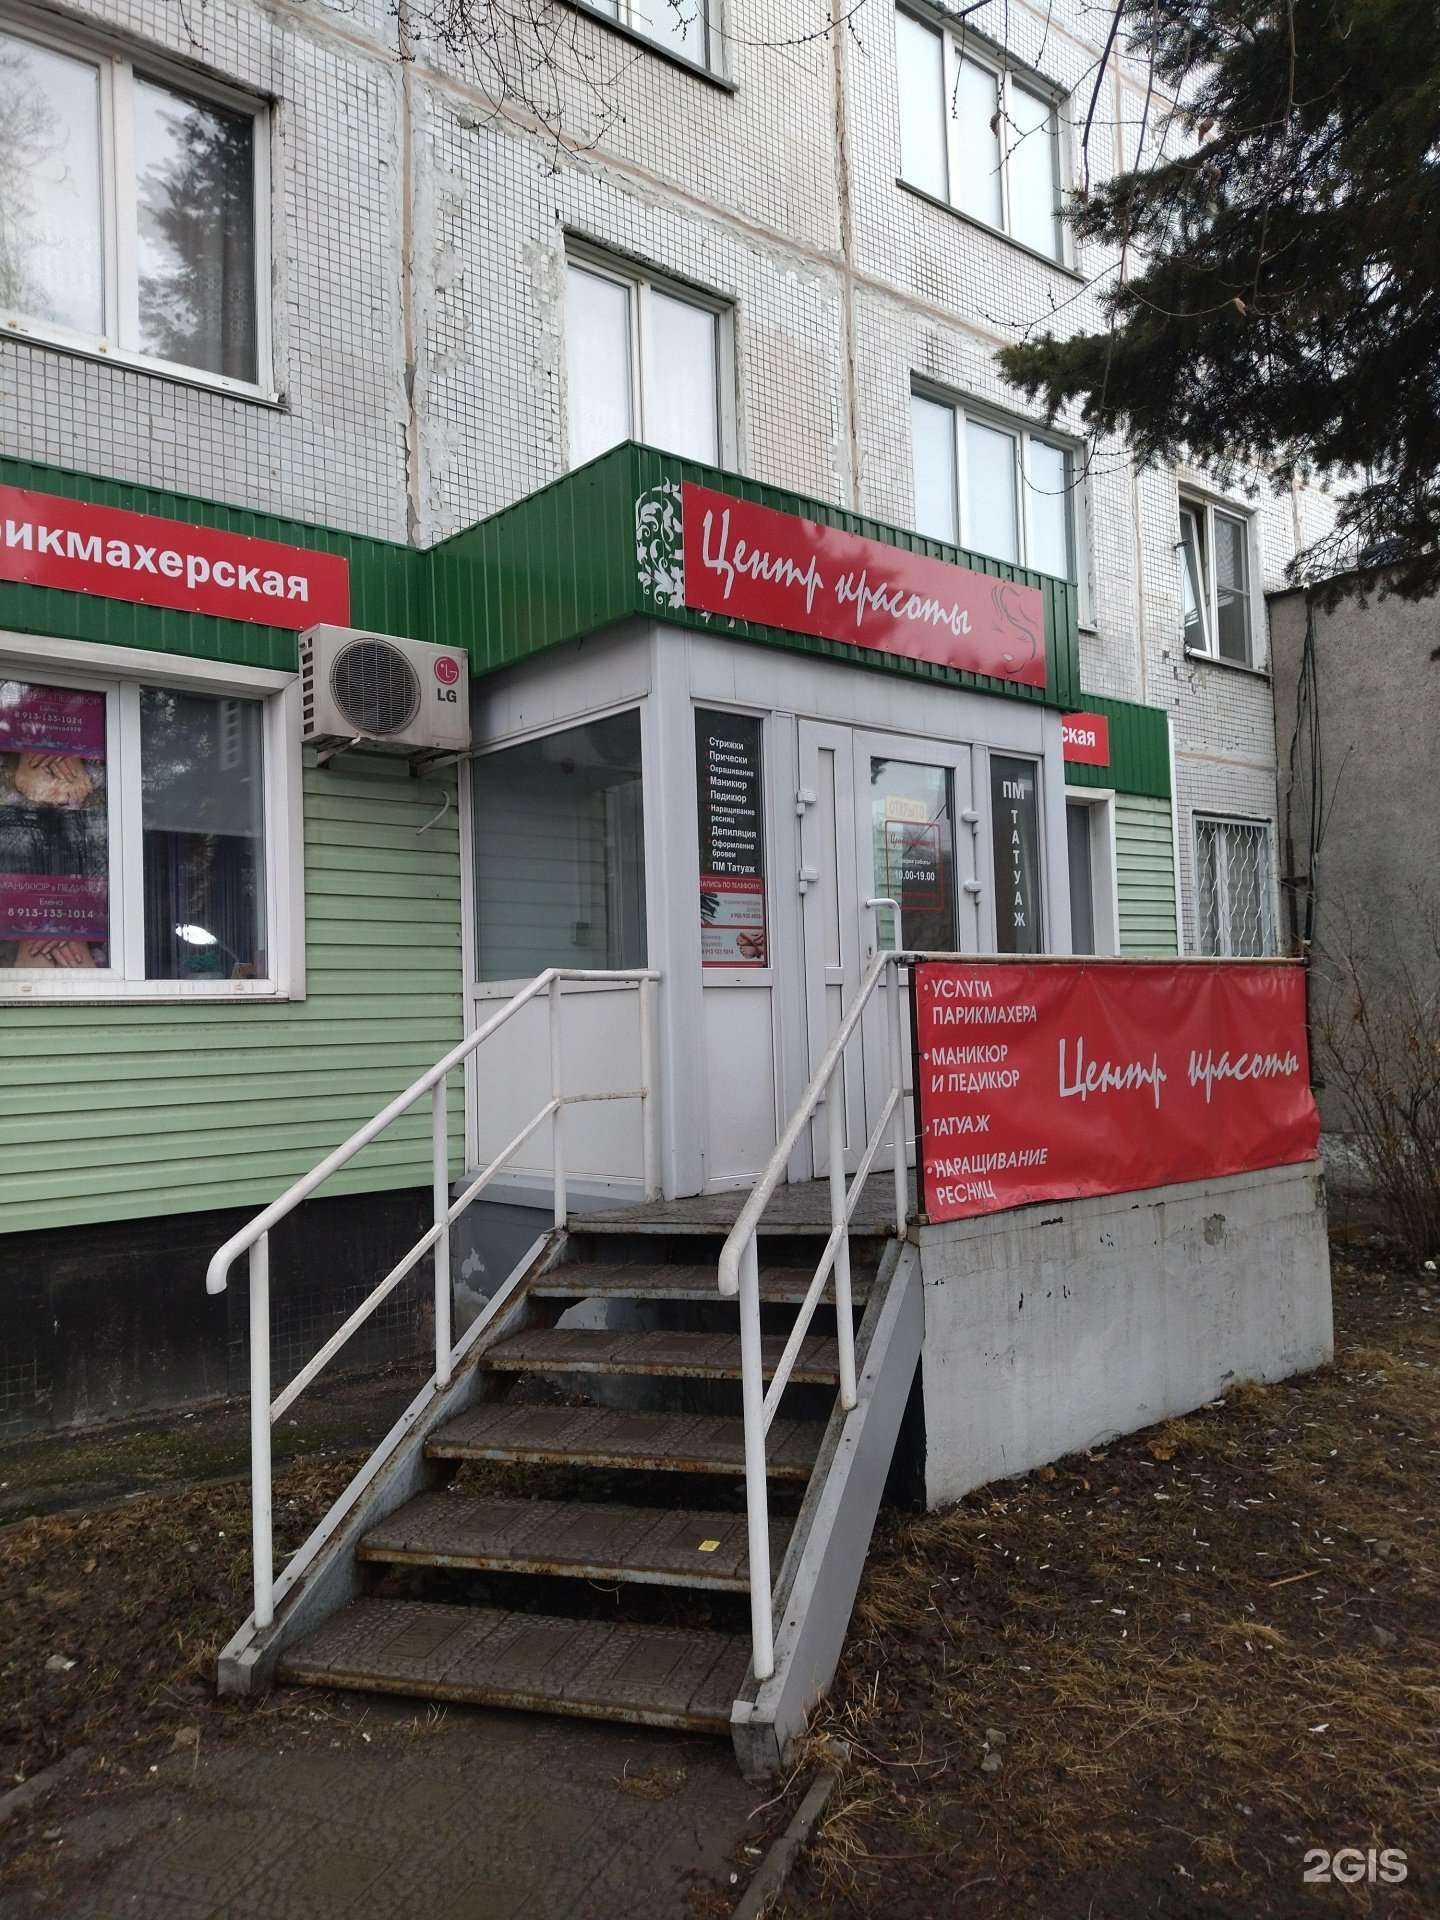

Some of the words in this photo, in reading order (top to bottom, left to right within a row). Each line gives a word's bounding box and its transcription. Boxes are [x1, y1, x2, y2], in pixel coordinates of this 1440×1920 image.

[0, 518, 309, 602] икмахерская
[702, 508, 824, 614] Центр
[834, 568, 972, 636] красоты
[437, 687, 457, 703] LG
[709, 736, 744, 750] Стрижки
[710, 750, 748, 764] Прически
[710, 776, 748, 791] Маникюр
[1003, 781, 1024, 800] ПМ
[711, 790, 747, 804] Педикюр
[711, 804, 755, 816] Наращивание
[711, 815, 735, 825] ресниц
[712, 826, 757, 839] Депиляция
[712, 839, 755, 850] Оформление
[712, 861, 726, 872] ПМ
[727, 862, 756, 875] Татуаж
[931, 979, 993, 998] УСЛУГИ
[932, 1005, 1037, 1024] ПАРИКМАХЕРА
[931, 1044, 1008, 1066] МАНИКЮР
[931, 1074, 944, 1093] И
[948, 1069, 1020, 1093] ПЕДИКЮР
[1058, 1036, 1168, 1110] Центр
[1187, 1048, 1300, 1105] красоты
[932, 1114, 990, 1137] ТАТУАЖ
[934, 1148, 1048, 1178] НАРАЩИВАНИЕ
[936, 1179, 997, 1206] РЕСНИЦ
